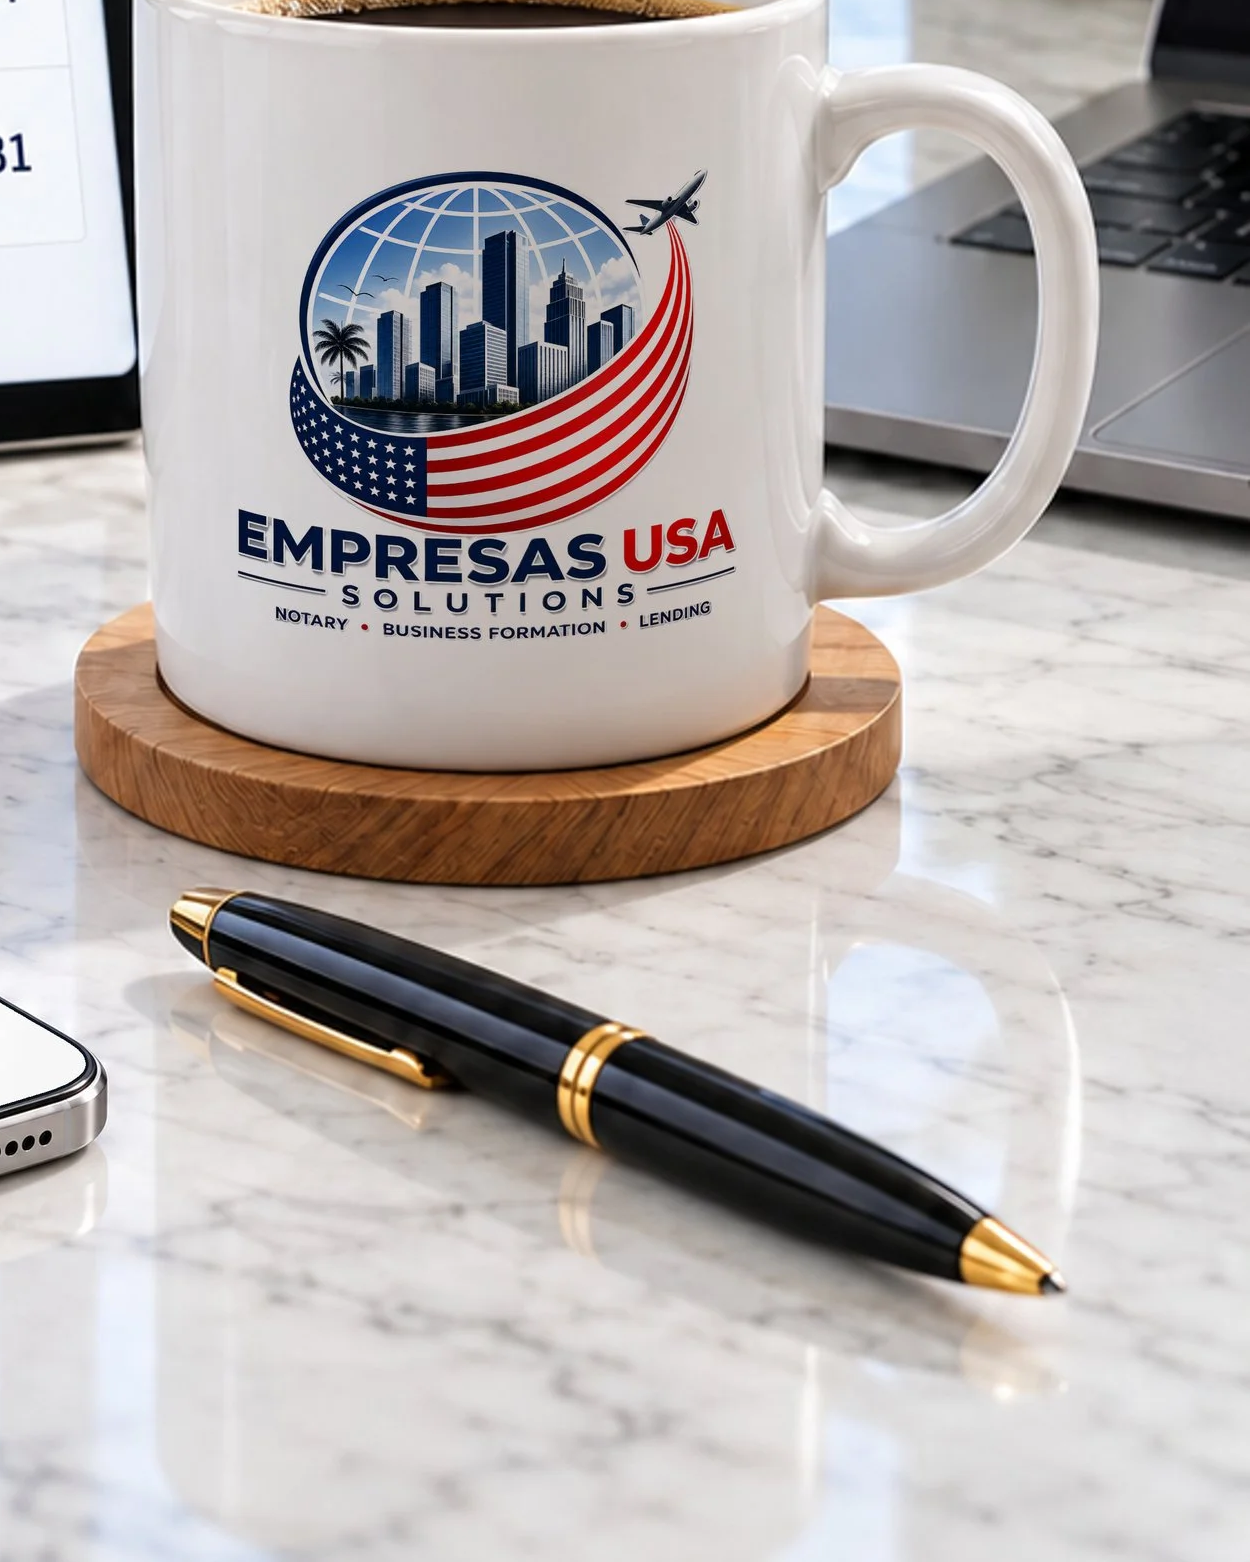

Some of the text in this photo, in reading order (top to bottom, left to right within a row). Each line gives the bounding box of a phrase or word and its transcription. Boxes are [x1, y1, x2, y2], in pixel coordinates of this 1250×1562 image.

[238, 508, 736, 582] EMPRESAS USA
[341, 583, 635, 614] SOLUTIONS
[275, 600, 712, 640] NOTARY BUSINESS FORMATION LENDING
